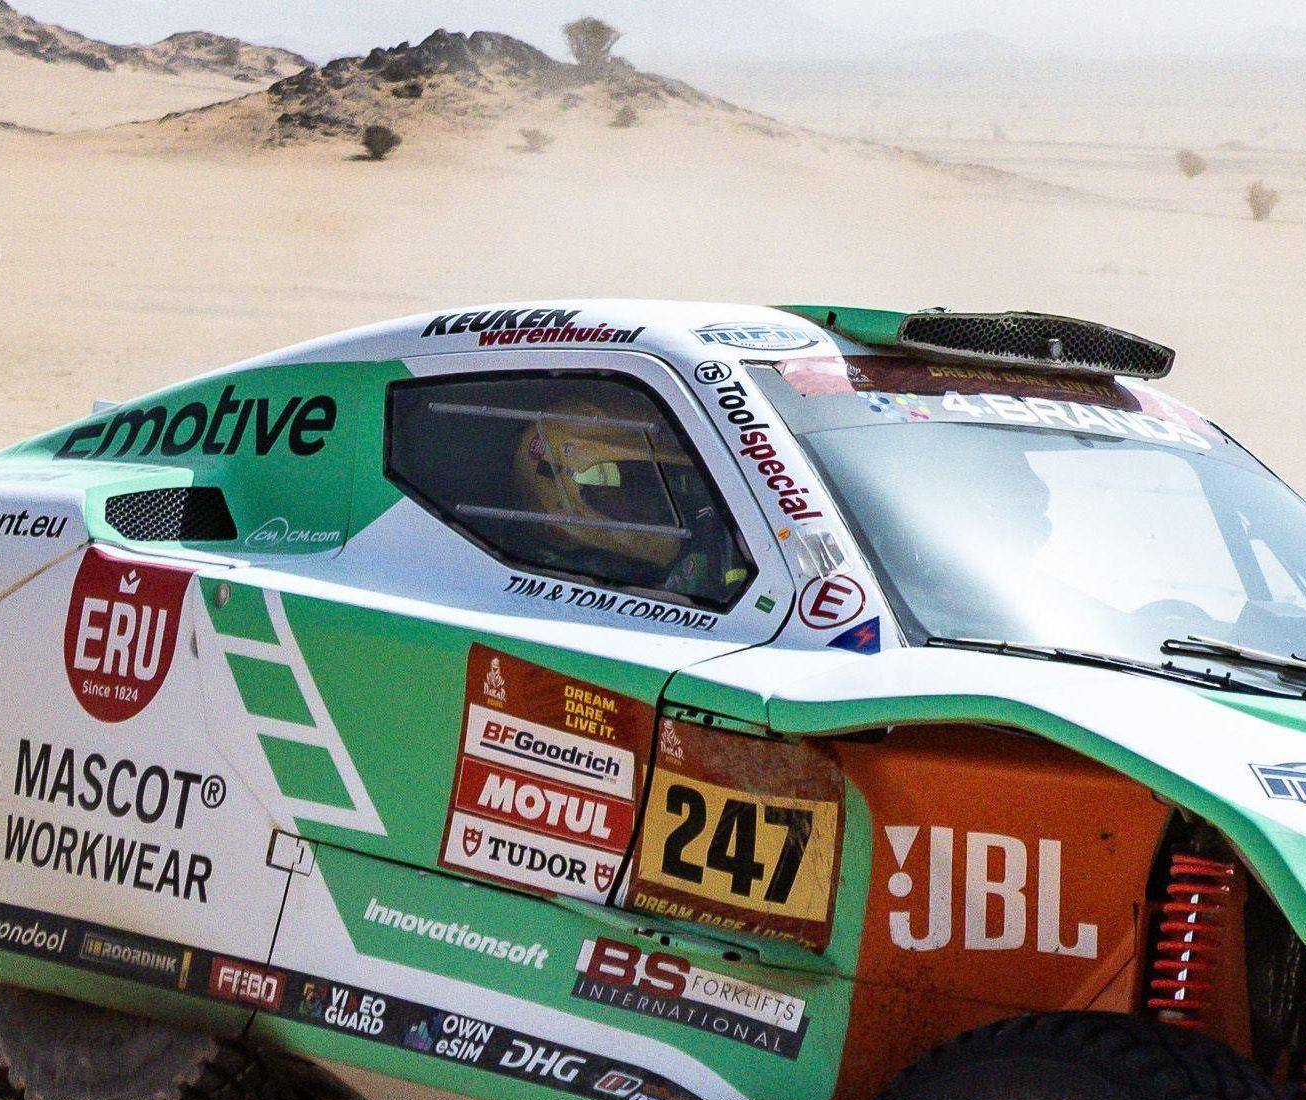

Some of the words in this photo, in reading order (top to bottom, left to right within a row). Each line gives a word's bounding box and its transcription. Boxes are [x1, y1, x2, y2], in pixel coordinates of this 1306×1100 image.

[421, 309, 582, 338] KEUKEN
[715, 381, 824, 521] Toolspecial
[287, 530, 340, 542] CM.com
[503, 576, 546, 597] TIM
[544, 584, 563, 600] &
[565, 588, 619, 612] TOM
[809, 579, 853, 621] E
[74, 597, 168, 681] ERU
[82, 680, 111, 698] Since
[114, 685, 139, 702] 1824
[565, 685, 618, 713] DREAM.
[565, 700, 607, 724] DARE.
[482, 720, 621, 777] BFGoodrich
[566, 715, 597, 735] LIVE
[600, 725, 617, 741] IT.
[477, 773, 612, 840] MOTUL
[4, 815, 213, 903] WORKWEAR
[487, 835, 588, 885] TUDOR
[660, 784, 814, 905] 247
[885, 826, 1098, 960] JBL
[363, 896, 550, 970] Innovationsoft
[586, 936, 691, 999] BS
[692, 974, 796, 1021] FORKLIFTS
[324, 1005, 384, 1036] GUARD
[442, 1015, 495, 1044] OWN
[578, 982, 782, 1053] INTERNATIONAL
[435, 1039, 484, 1063] eSIM
[499, 1039, 587, 1083] DHG
